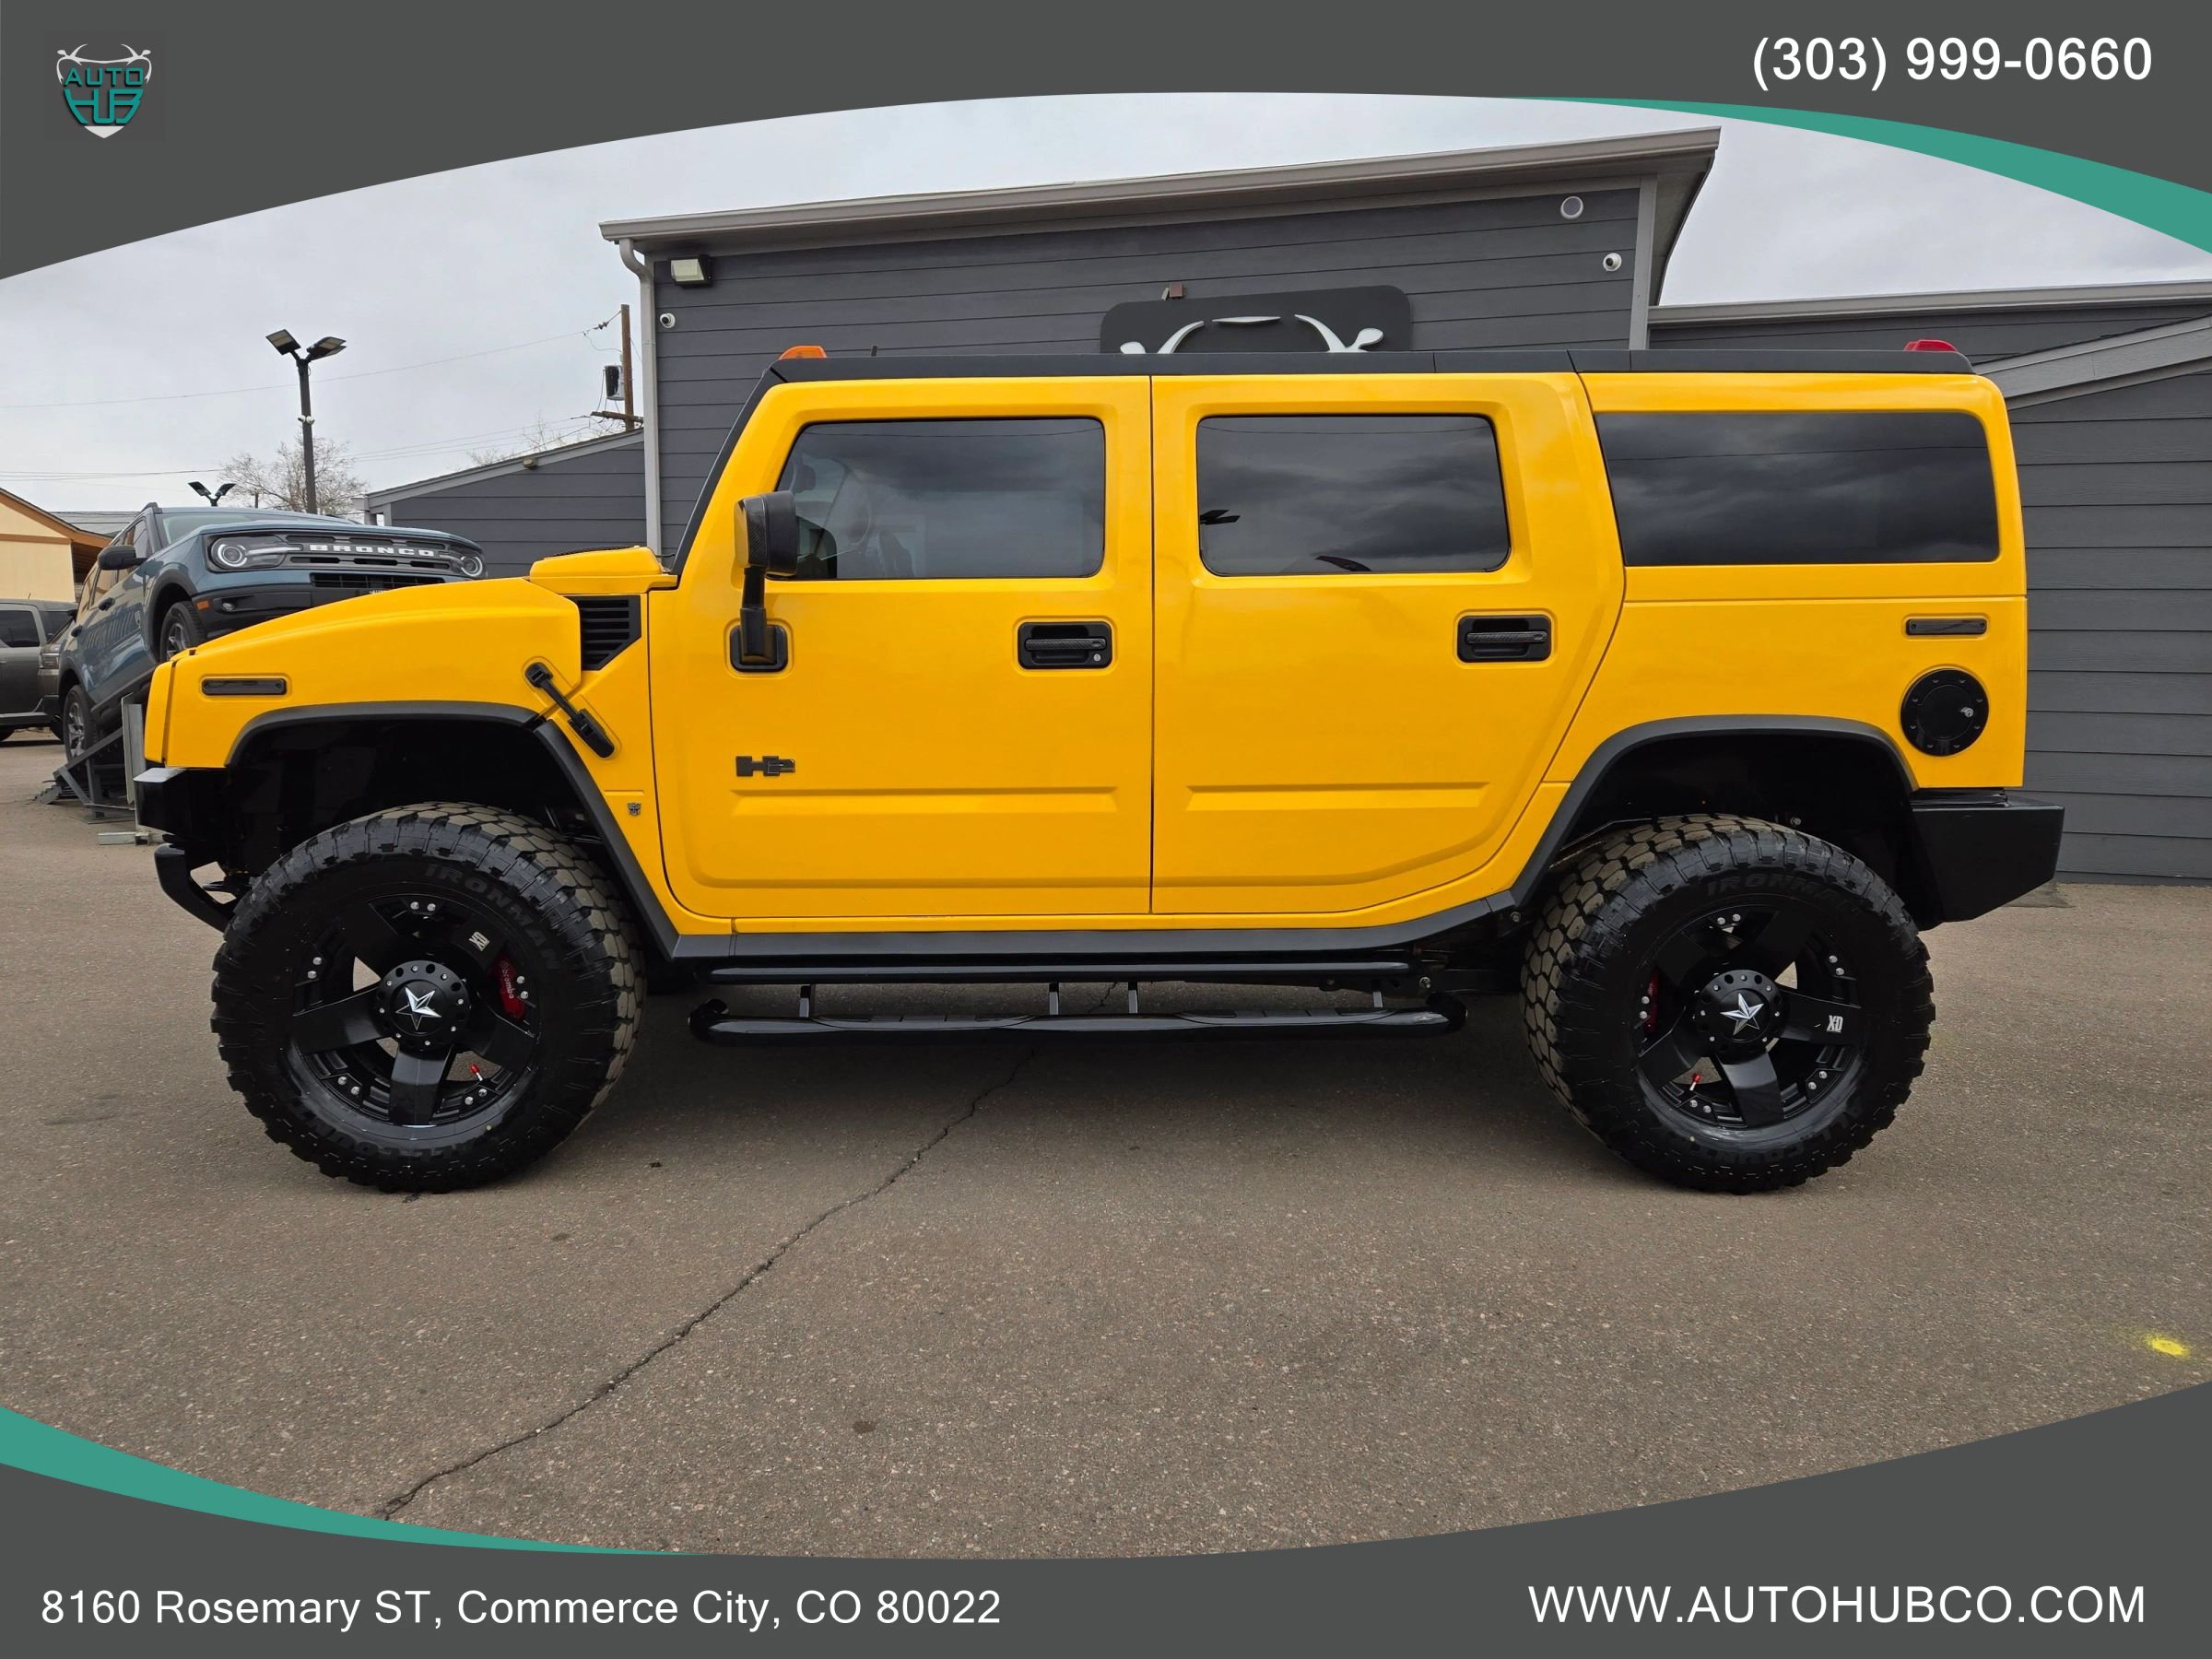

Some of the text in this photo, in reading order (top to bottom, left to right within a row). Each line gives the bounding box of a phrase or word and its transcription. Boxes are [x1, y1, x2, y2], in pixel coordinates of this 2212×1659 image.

[310, 544, 434, 557] BRONCO
[1707, 873, 1864, 915] IRONMA
[425, 863, 559, 969] IRONMAN
